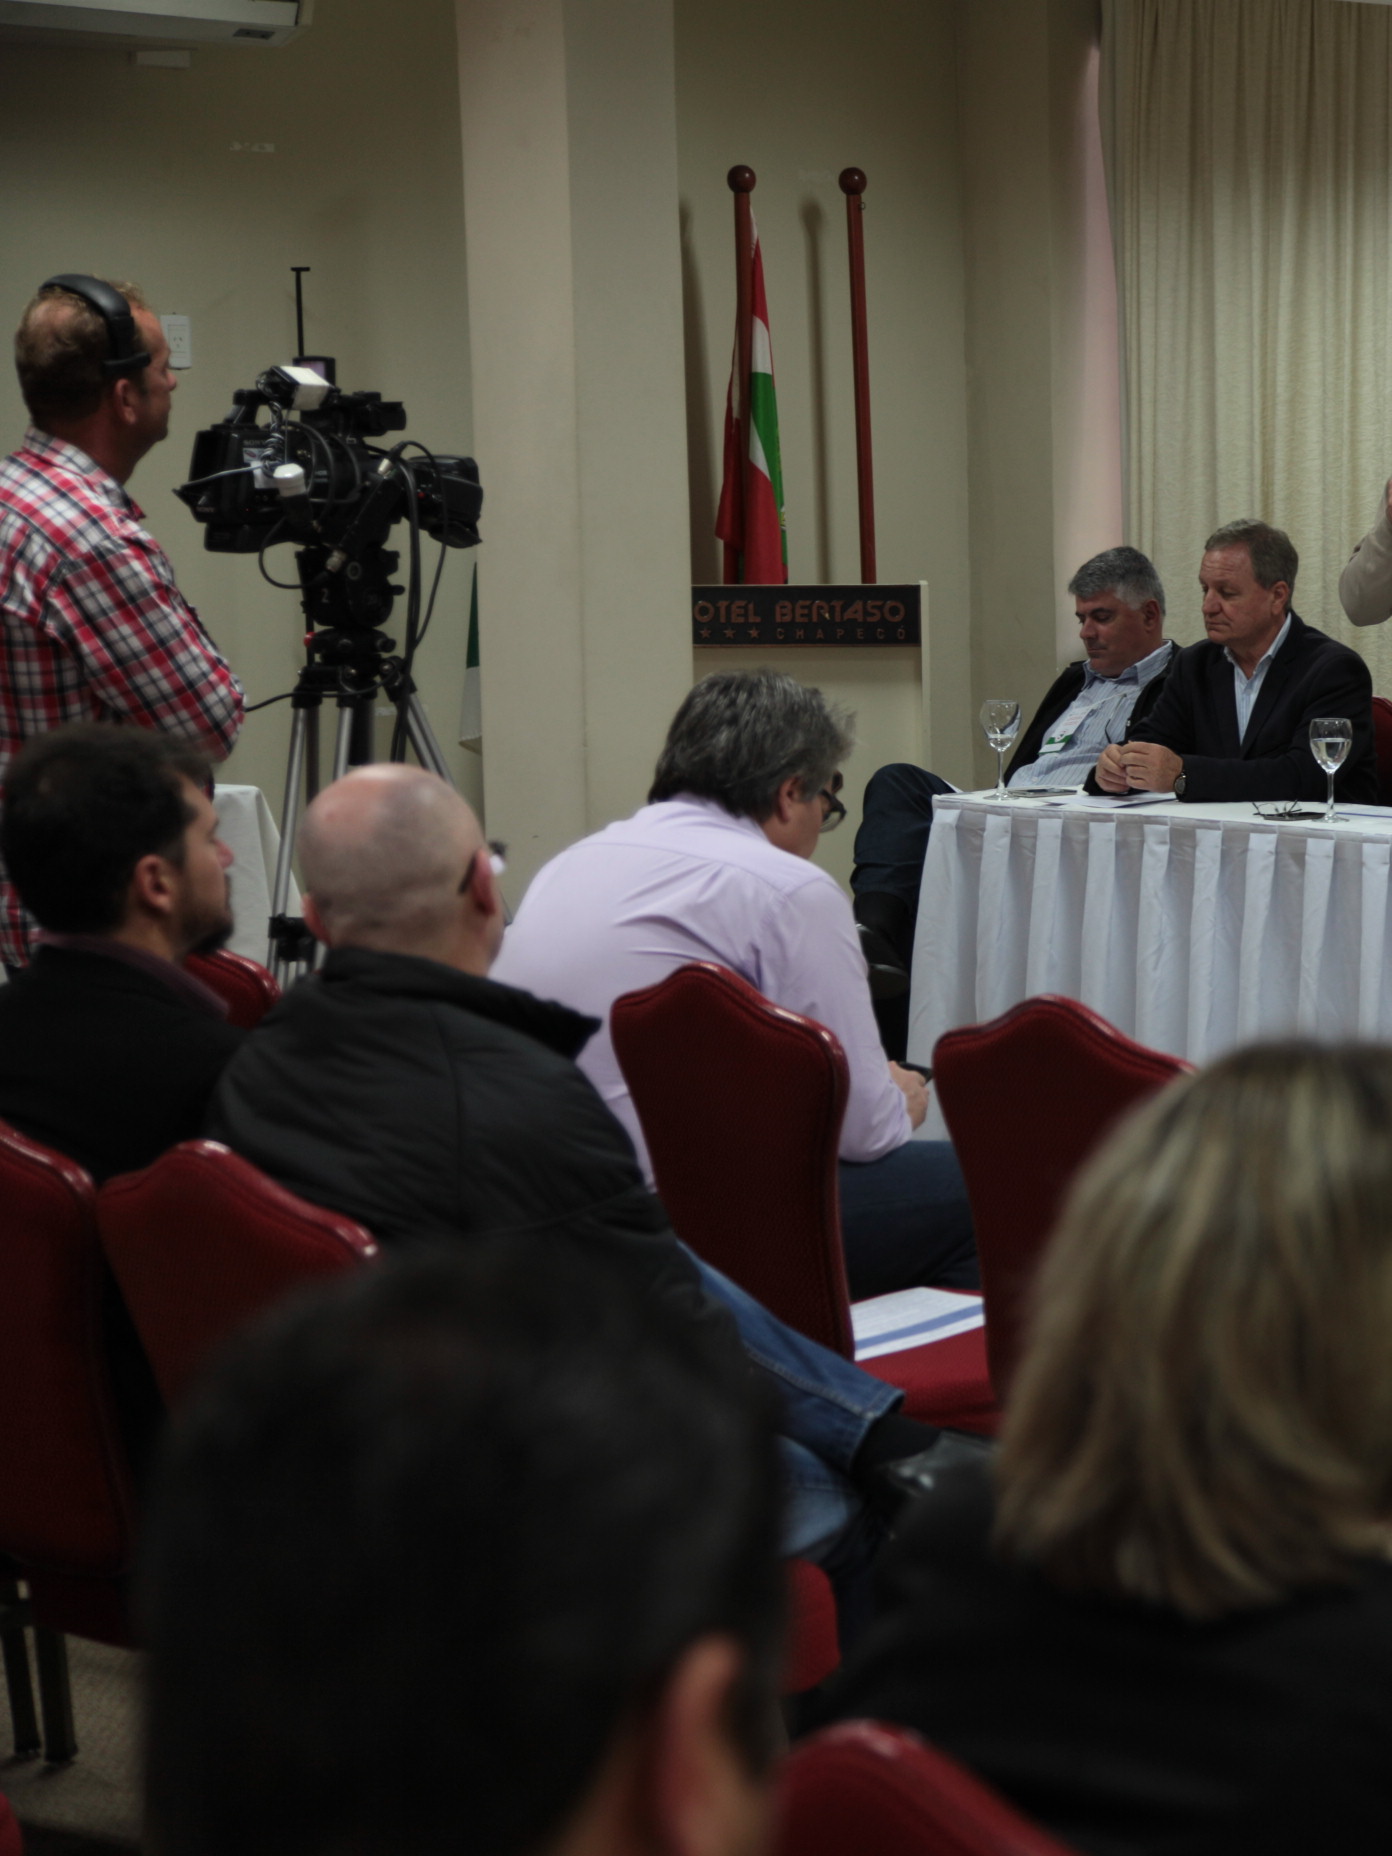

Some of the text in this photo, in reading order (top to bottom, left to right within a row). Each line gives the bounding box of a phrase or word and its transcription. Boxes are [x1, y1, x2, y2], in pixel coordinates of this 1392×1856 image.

[693, 600, 906, 624] OTEL BERTASO
[776, 626, 907, 640] CHAPECÓ
